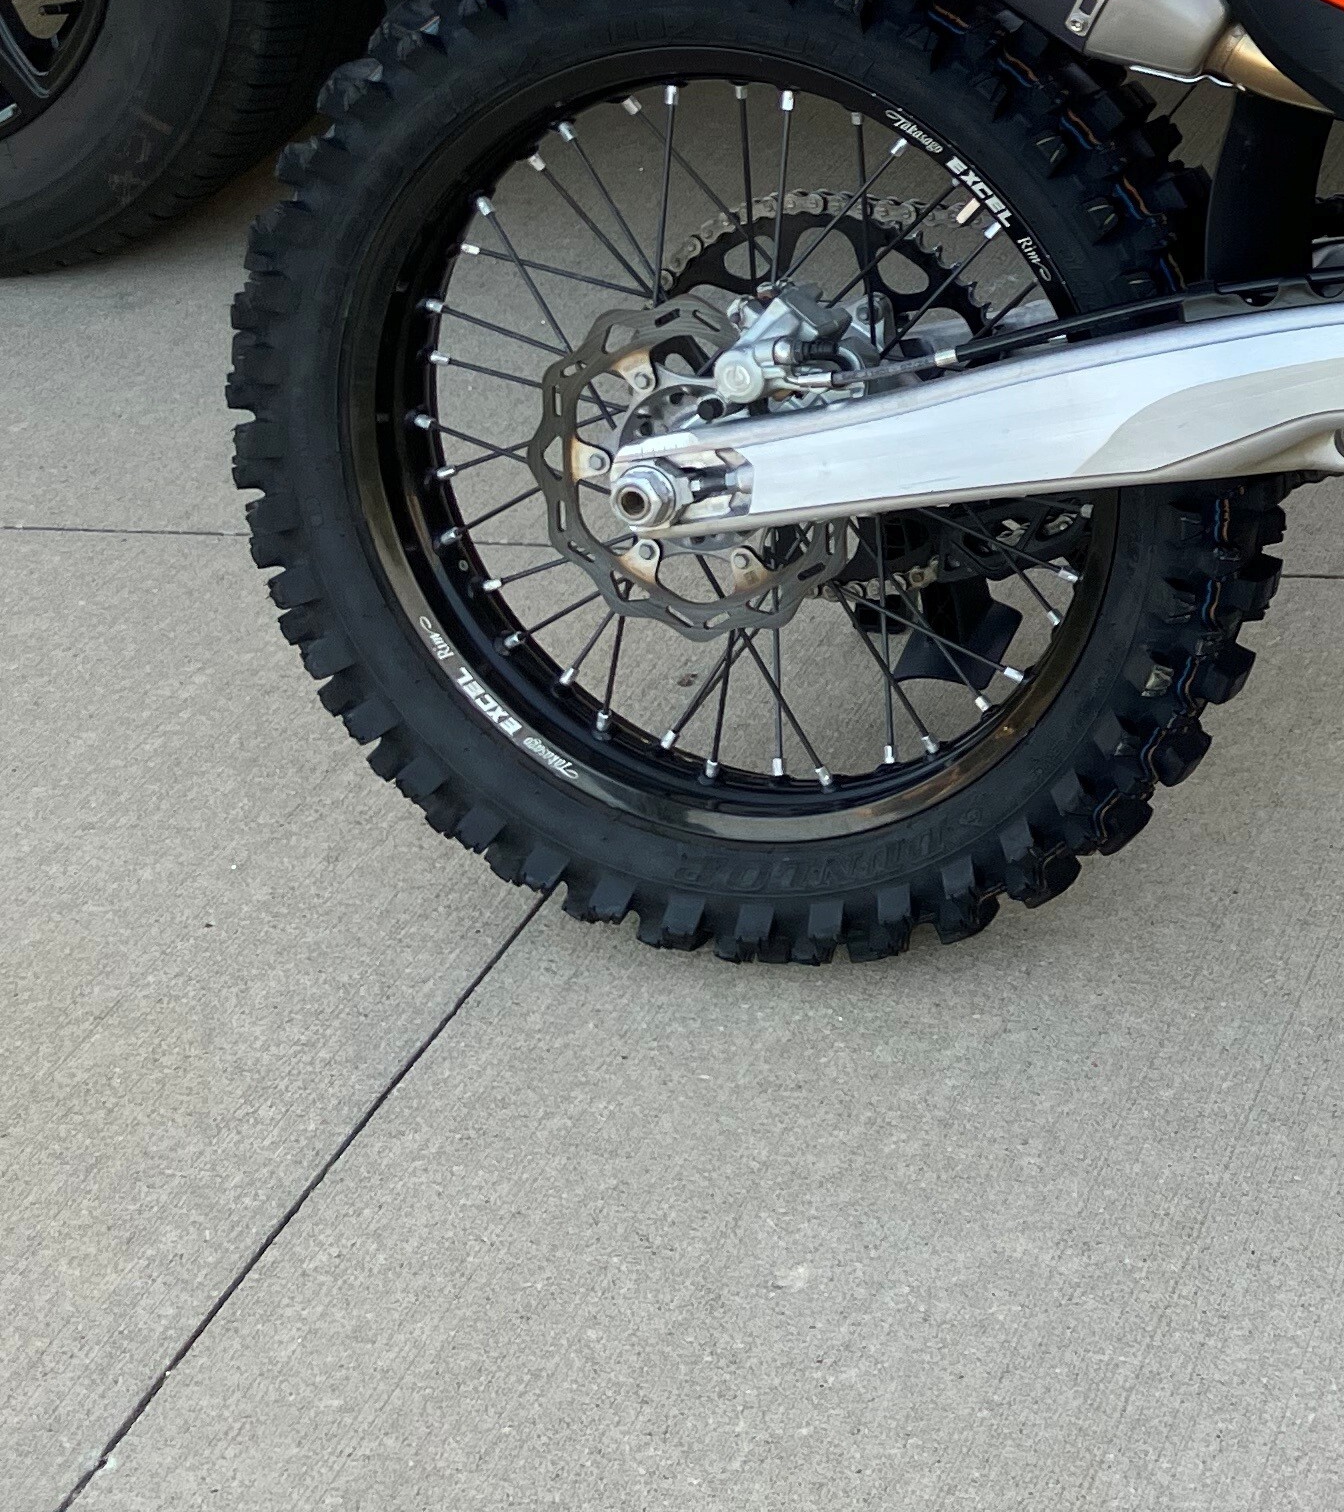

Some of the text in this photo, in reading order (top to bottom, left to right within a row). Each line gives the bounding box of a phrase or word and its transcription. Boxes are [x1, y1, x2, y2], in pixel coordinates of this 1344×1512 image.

[885, 109, 1051, 282] Takasago EXCEL Rim
[420, 616, 454, 660] Rim
[456, 667, 522, 737] EXCEL
